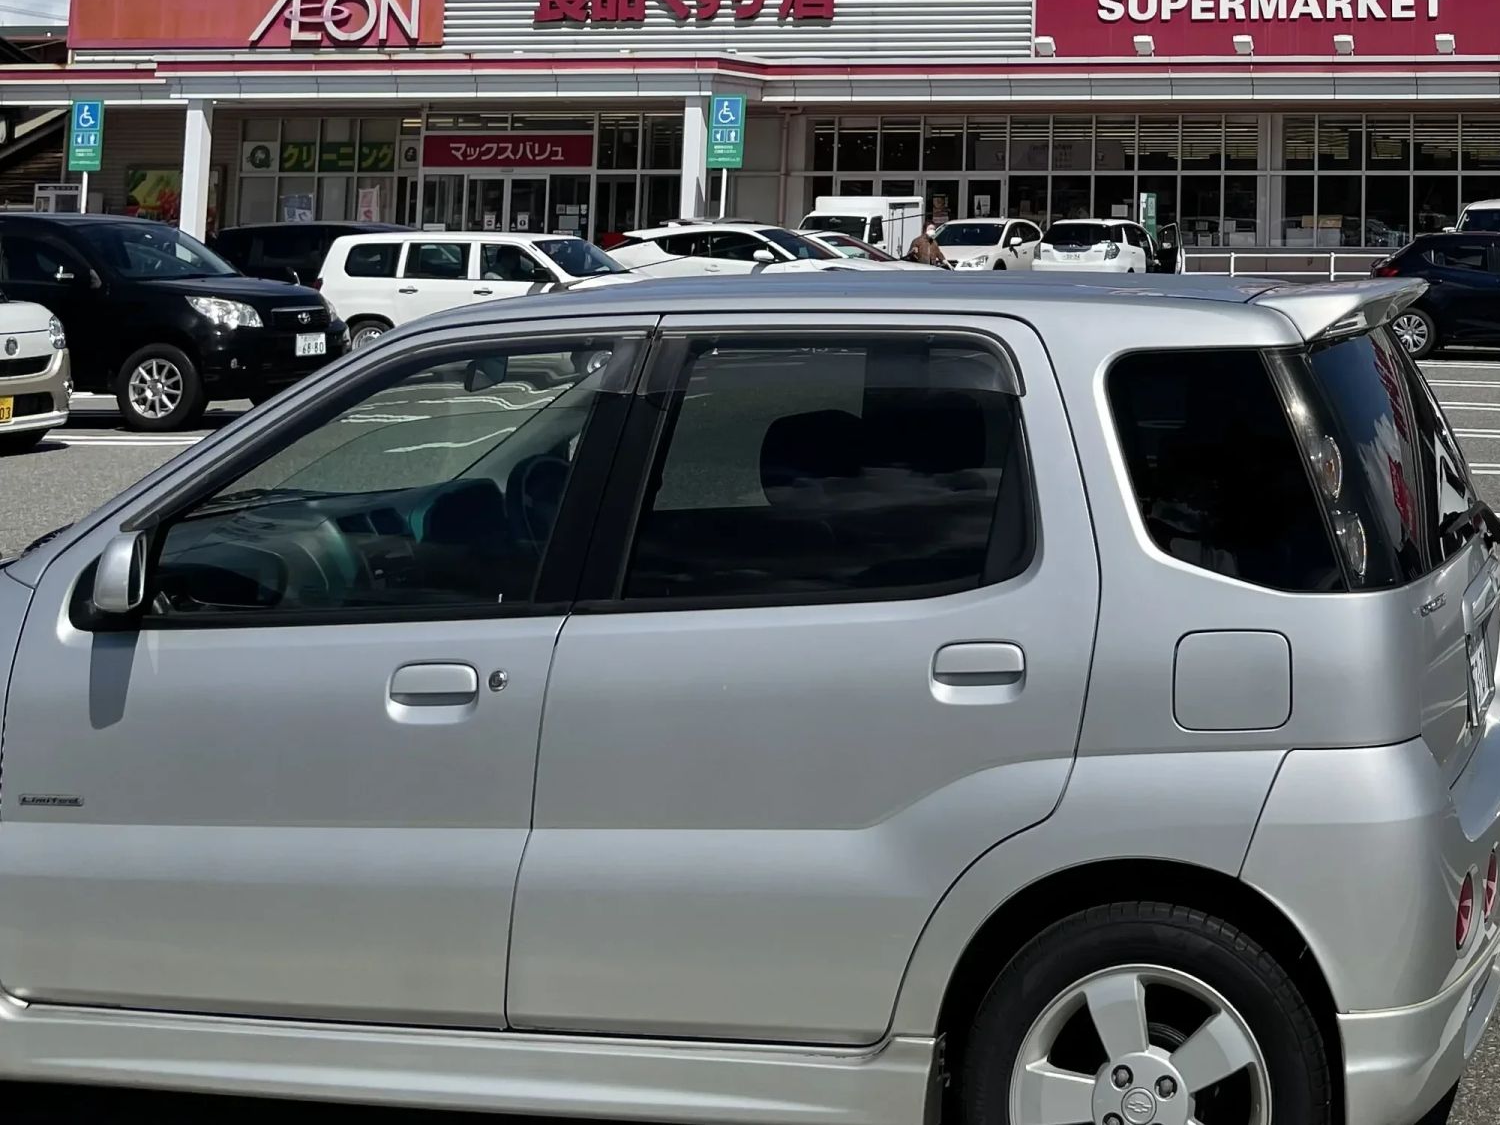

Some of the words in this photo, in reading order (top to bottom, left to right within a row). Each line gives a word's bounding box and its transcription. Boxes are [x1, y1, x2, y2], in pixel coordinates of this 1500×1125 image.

[282, 143, 394, 170] クリーニング
[449, 141, 565, 161] マックスバリュ
